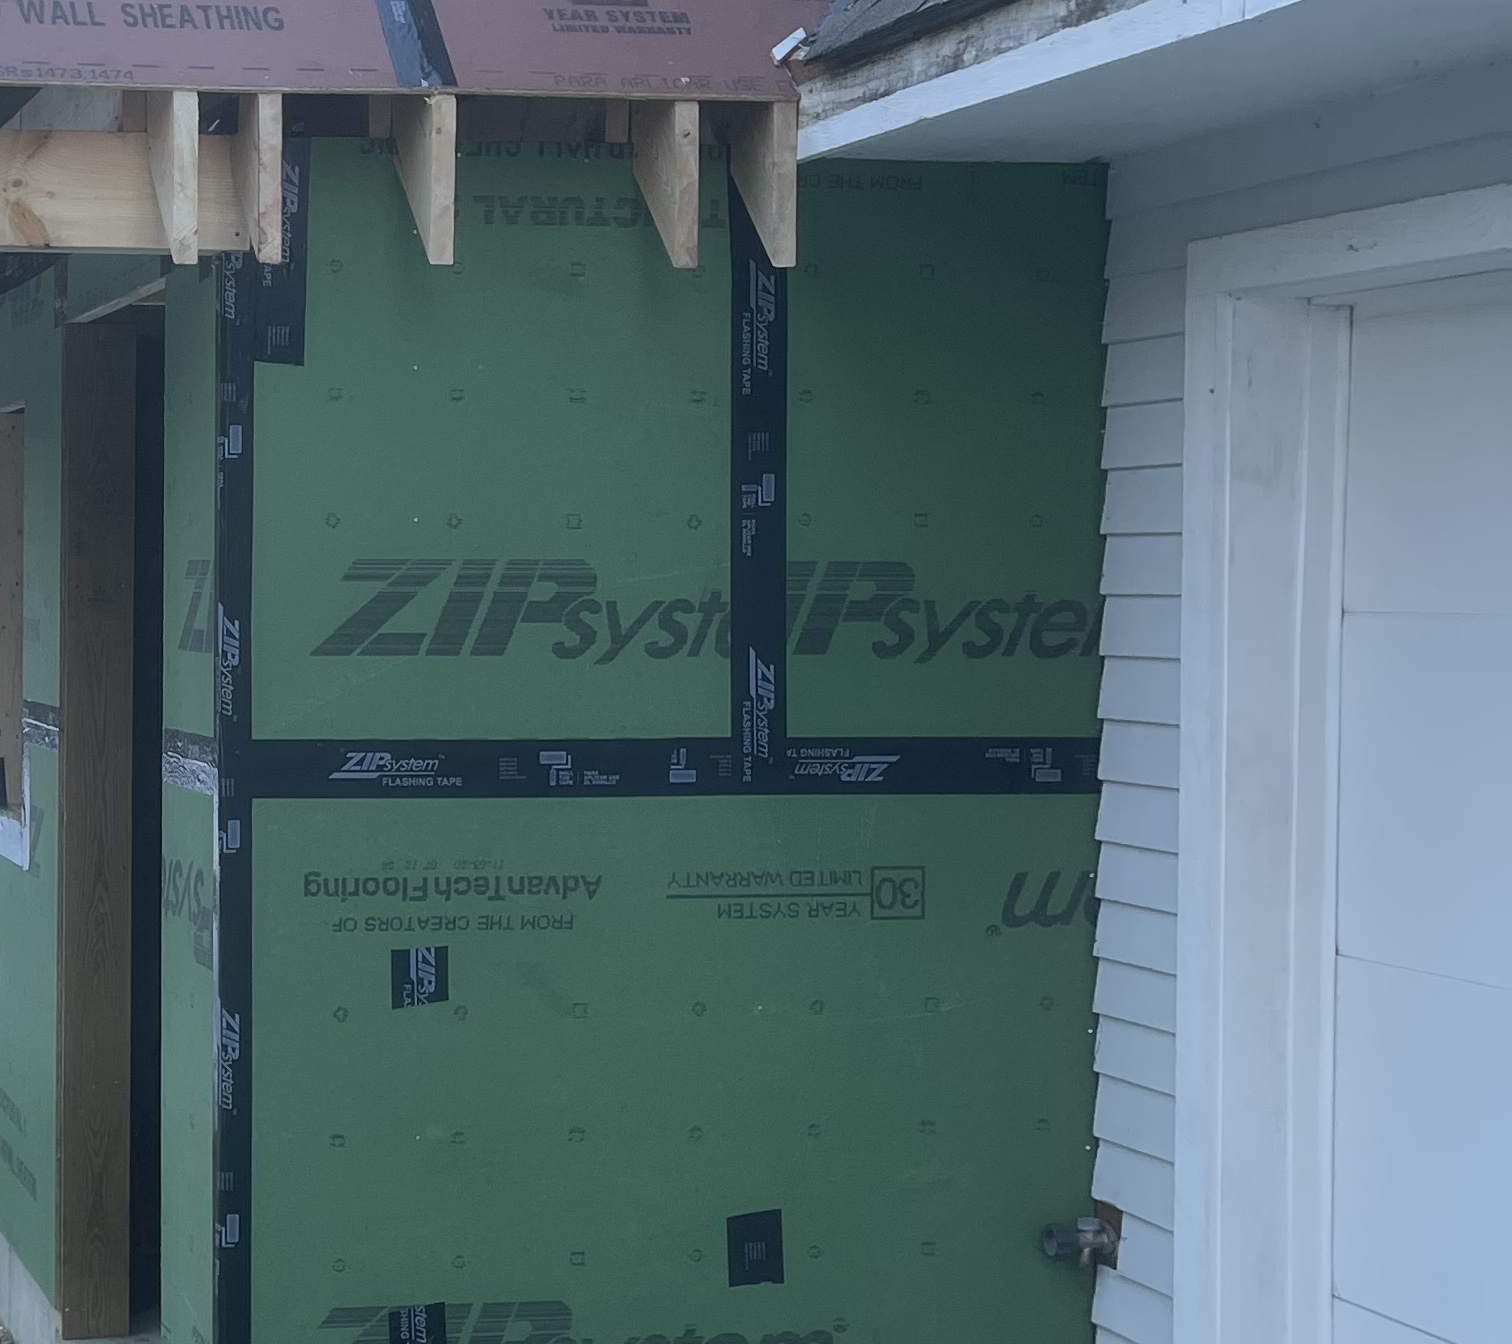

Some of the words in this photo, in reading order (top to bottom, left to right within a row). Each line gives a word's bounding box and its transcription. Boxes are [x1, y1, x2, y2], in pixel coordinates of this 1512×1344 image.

[120, 2, 286, 33] SHEATHING
[541, 7, 599, 23] YEAR
[607, 9, 692, 26] SYSTEM
[757, 265, 775, 372] ZIPsystem
[742, 312, 751, 366] FLASHING
[742, 367, 751, 395] TAPE
[220, 618, 240, 717] ZIPsystem
[757, 657, 775, 758] ZIPsystem
[742, 701, 752, 754] FLASHING
[341, 752, 440, 772] ZIPsystem
[799, 747, 850, 758] FLASHING
[742, 756, 752, 783] TAPE
[793, 762, 889, 782] ZIPsystem
[381, 777, 435, 787] FLASHING
[437, 777, 463, 787] TAPE
[666, 870, 784, 888] WARRANTY
[790, 869, 864, 887] LIMITED
[874, 874, 921, 913] 30
[717, 901, 801, 920] SYSTEM
[807, 901, 862, 918] YEAR
[331, 916, 358, 933] OF
[364, 915, 471, 933] CREATORS
[477, 914, 515, 932] THE
[520, 913, 575, 932] FROM
[221, 1008, 241, 1110] ZIPsystem
